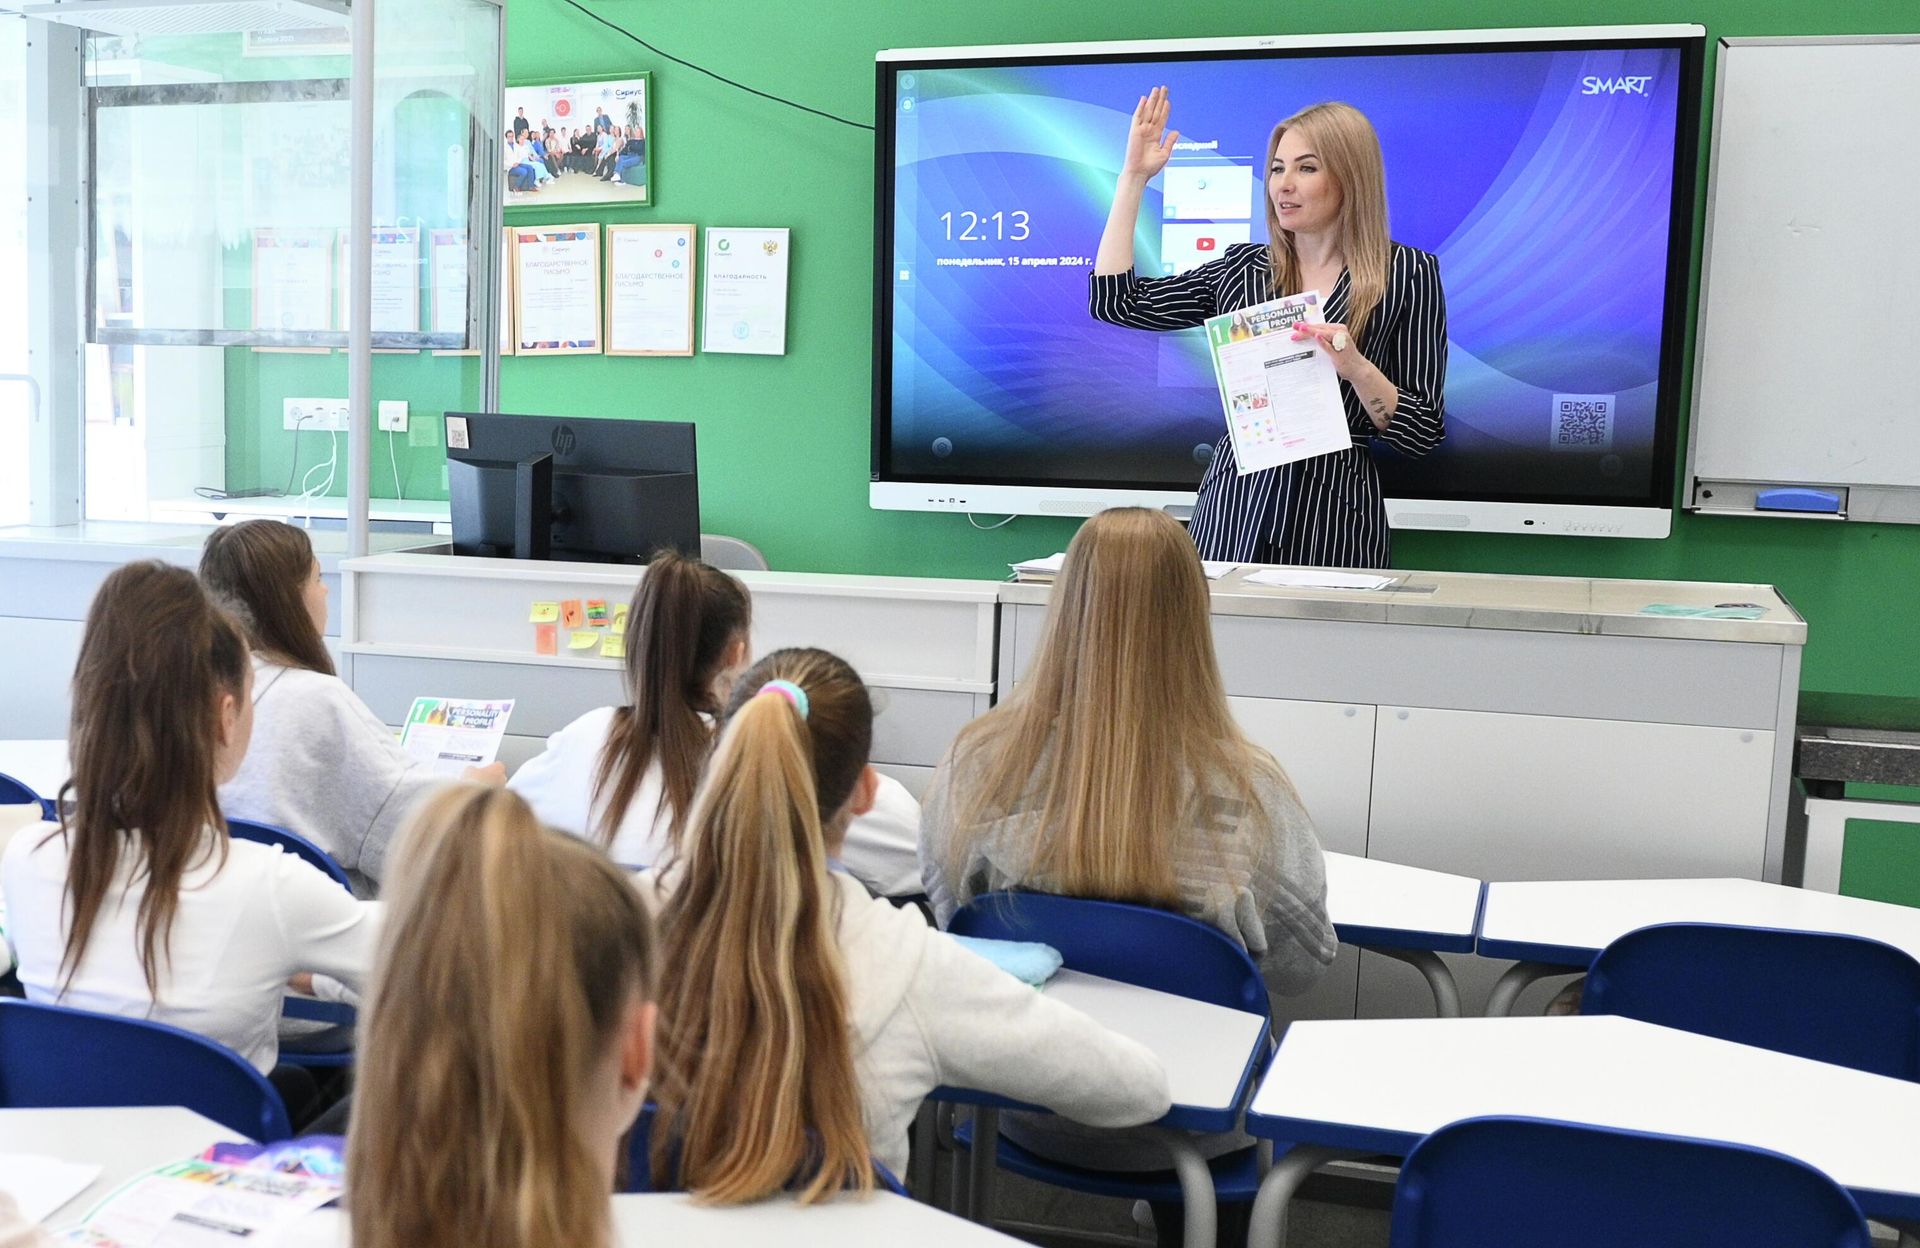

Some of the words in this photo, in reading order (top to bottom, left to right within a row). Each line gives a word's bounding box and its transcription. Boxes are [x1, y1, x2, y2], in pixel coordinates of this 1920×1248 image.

[940, 210, 1030, 241] 12:13
[936, 256, 1005, 267] понедельник,
[1008, 256, 1019, 265] 15
[1021, 257, 1057, 267] апреля
[1059, 256, 1083, 265] 2024
[1085, 257, 1093, 265] г.
[1250, 304, 1305, 323] PERSONALITY
[1270, 314, 1303, 328] PROFILE
[1212, 325, 1223, 344] 1
[555, 425, 573, 456] hp
[451, 708, 500, 718] PERSONALITY
